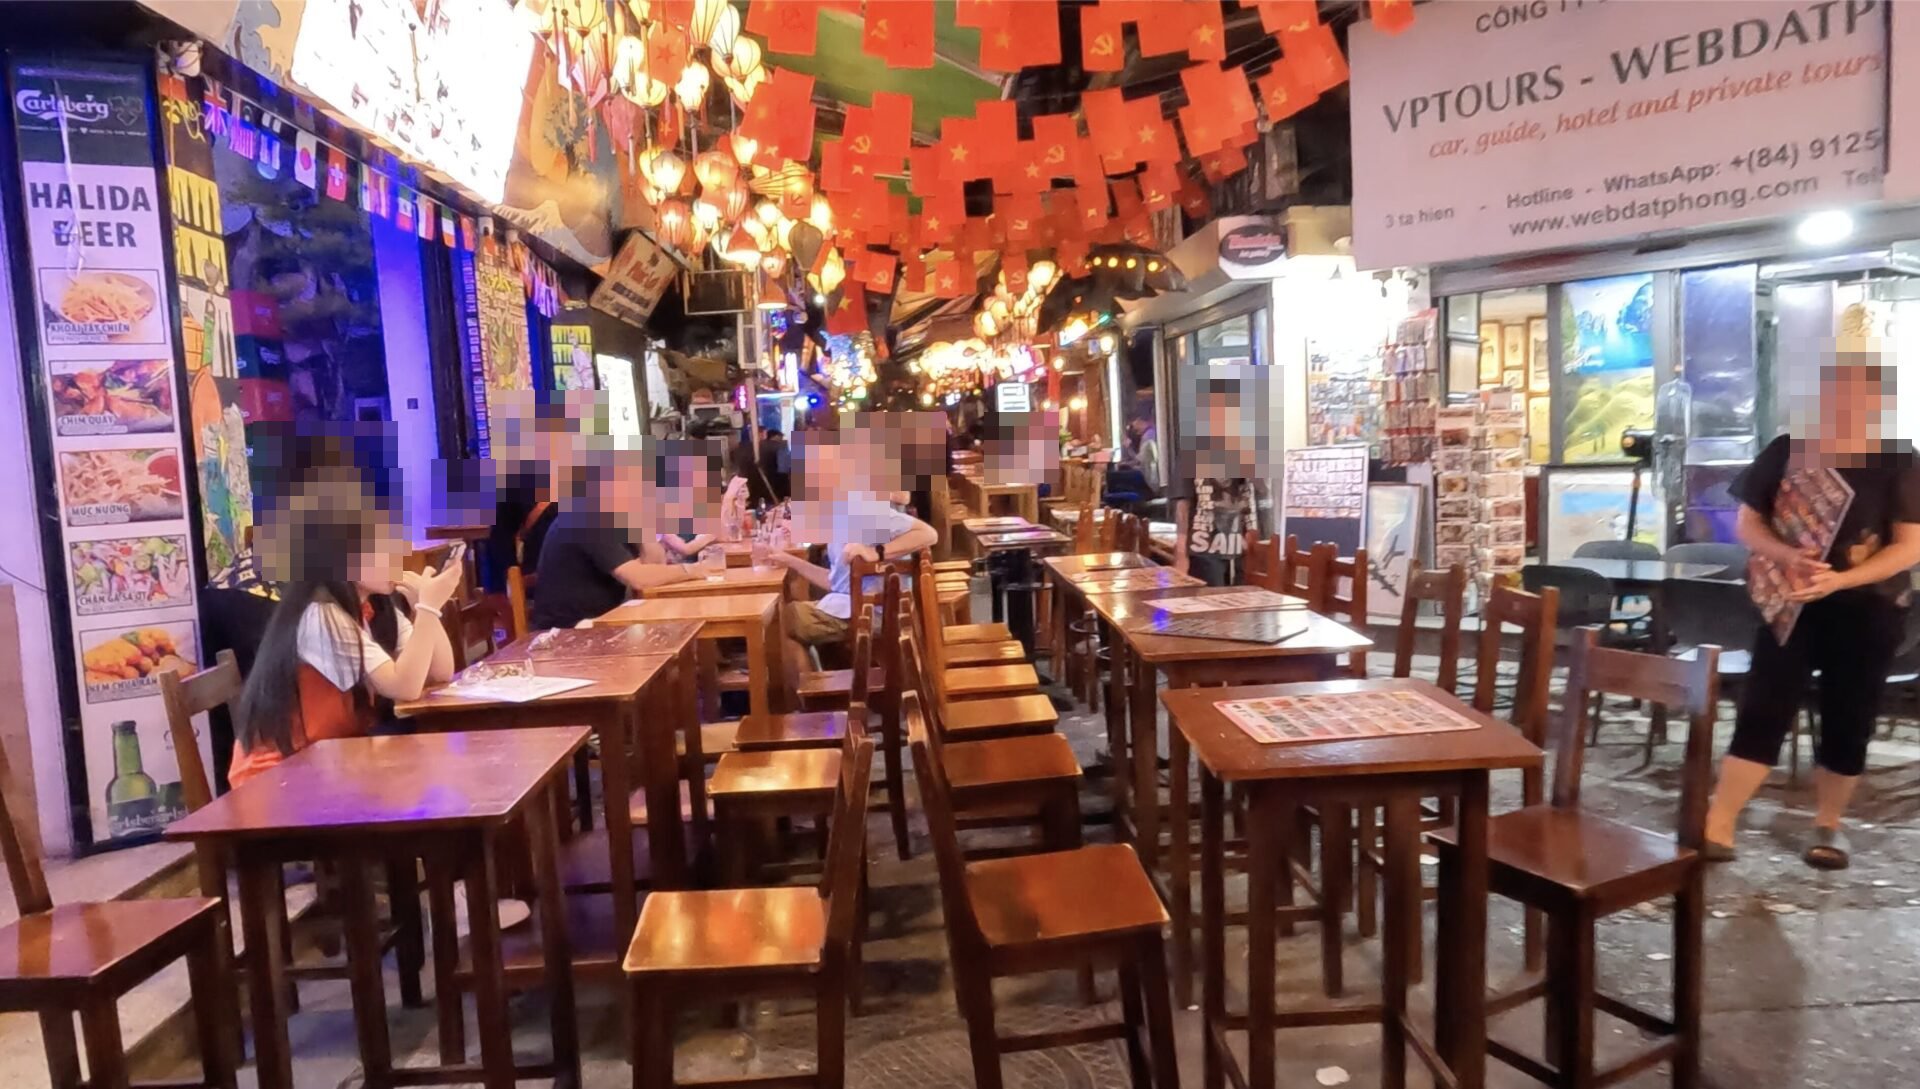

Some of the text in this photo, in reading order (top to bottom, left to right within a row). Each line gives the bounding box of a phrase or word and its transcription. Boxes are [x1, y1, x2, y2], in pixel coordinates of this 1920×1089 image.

[1476, 0, 1548, 33] CÔNG
[1382, 65, 1564, 133] VPTOURS
[1610, 0, 1876, 85] WEBDATP
[16, 90, 109, 122] Carlberg
[1476, 121, 1546, 155] guide,
[1555, 100, 1618, 133] hotel
[1626, 88, 1680, 120] and
[1687, 69, 1792, 112] private
[29, 182, 152, 212] HALIDA
[1506, 186, 1573, 209] Hotline
[1604, 161, 1722, 193] WhatsApp:
[1730, 142, 1799, 173] +(84)
[1509, 175, 1819, 236] www.webdatphong.com
[53, 220, 137, 248] BEER
